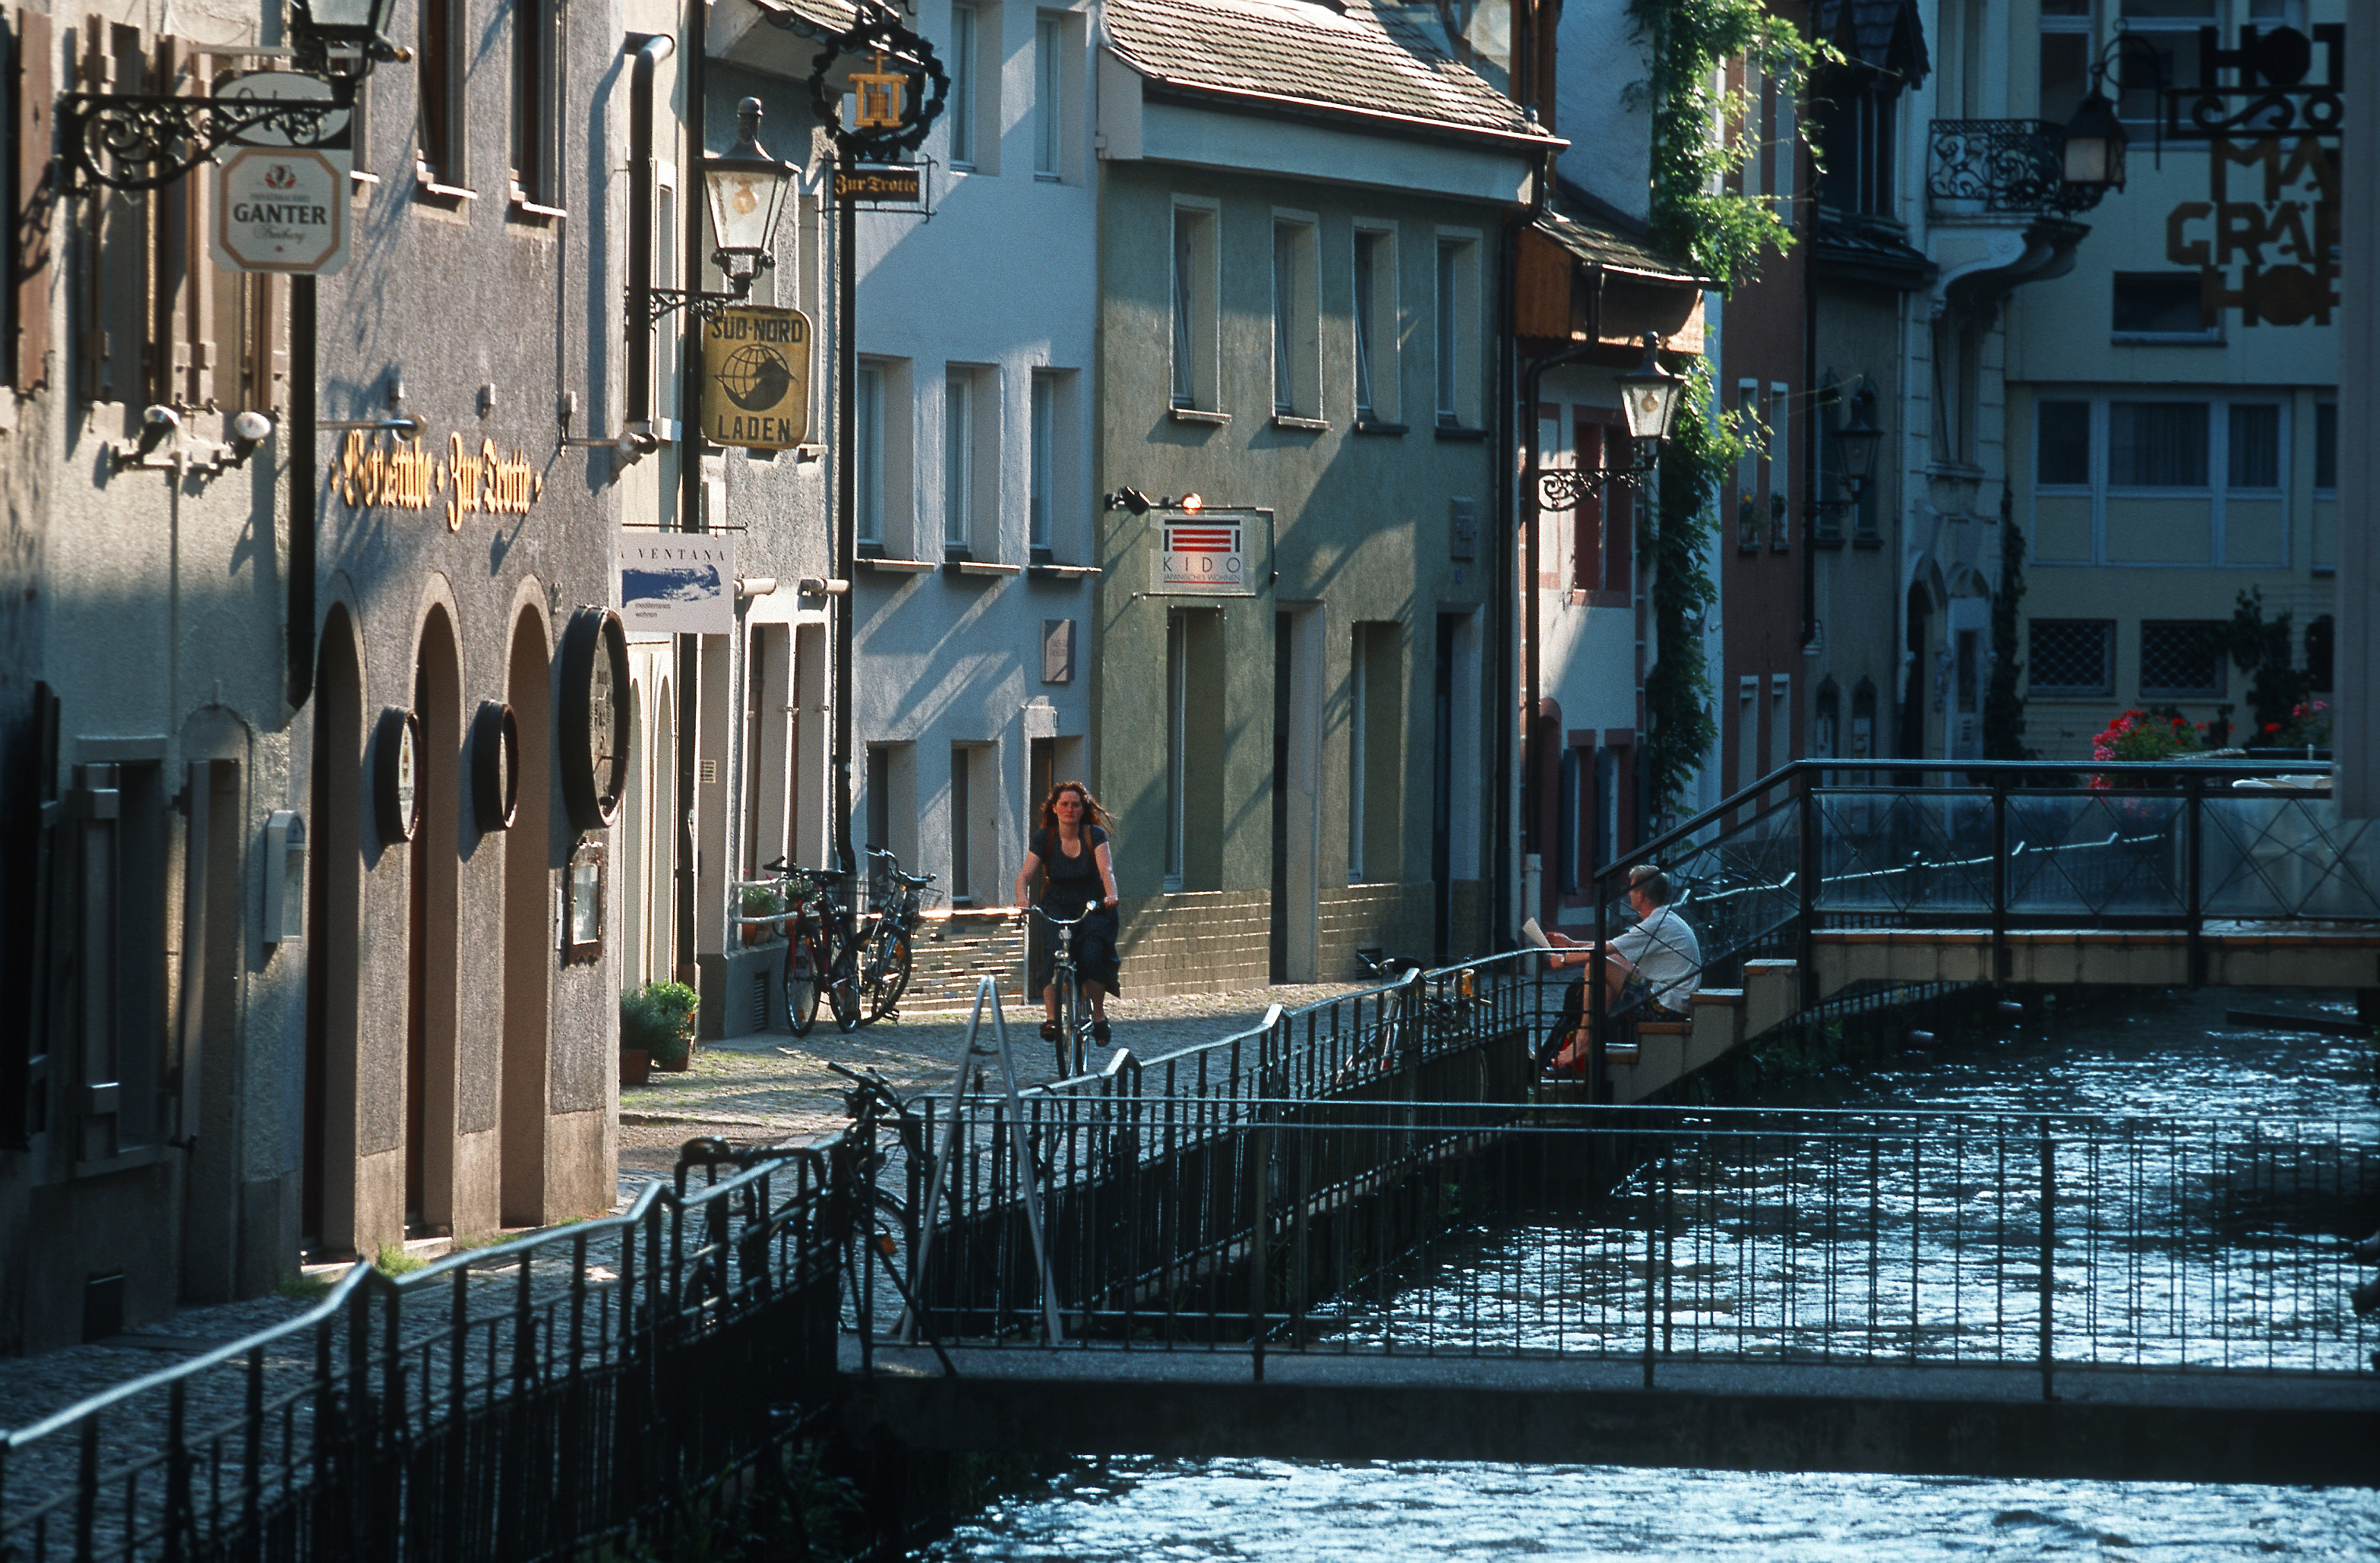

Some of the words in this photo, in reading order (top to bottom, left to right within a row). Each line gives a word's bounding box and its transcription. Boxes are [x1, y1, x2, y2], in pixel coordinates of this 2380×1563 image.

[834, 174, 866, 195] Zur
[867, 175, 918, 193] Trotte
[233, 202, 326, 224] GANTER
[711, 316, 802, 343] SÜD-NORD
[718, 415, 790, 441] LADEN
[447, 431, 482, 531] Zur
[482, 437, 531, 513] Trotte
[639, 548, 724, 560] VENTANA
[1163, 556, 1241, 573] KIDO
